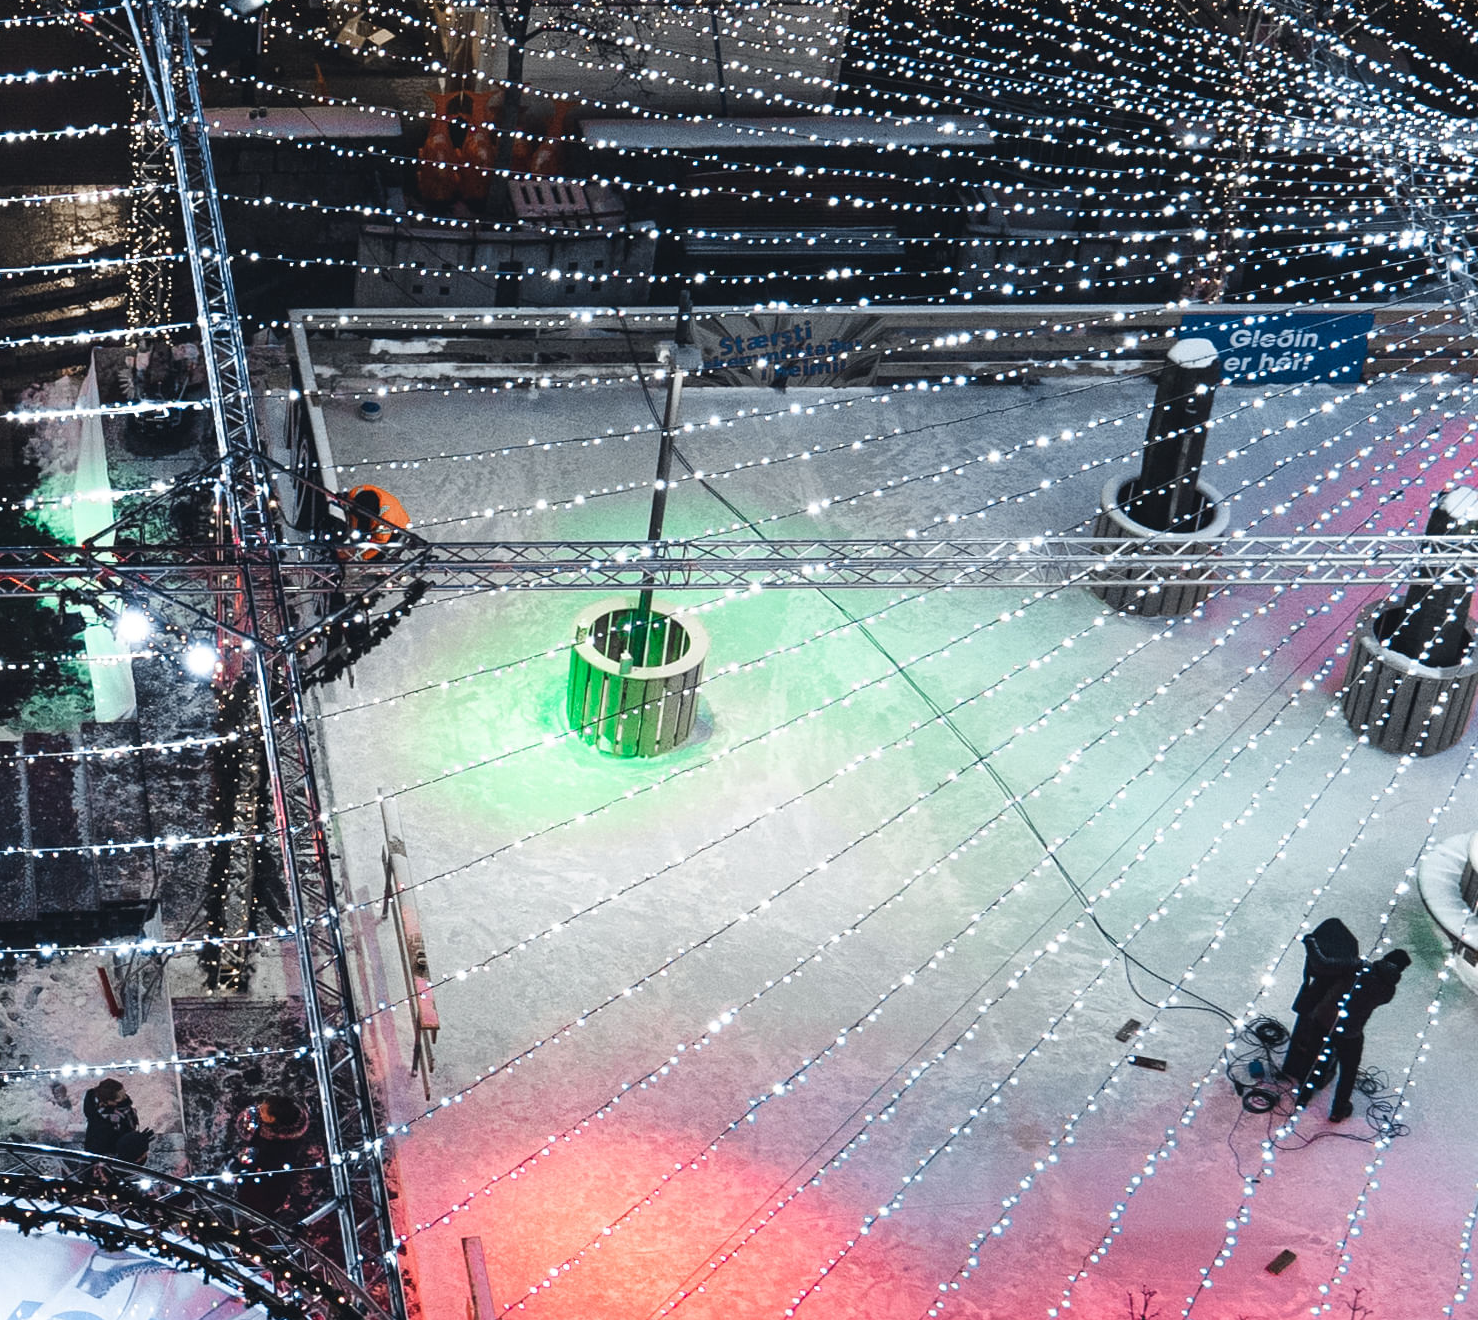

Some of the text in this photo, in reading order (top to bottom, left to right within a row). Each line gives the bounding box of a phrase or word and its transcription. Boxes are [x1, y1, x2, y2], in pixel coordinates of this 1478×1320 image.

[719, 320, 813, 356] Stærsti
[1229, 329, 1319, 348] Gleðin
[1223, 356, 1253, 371] er
